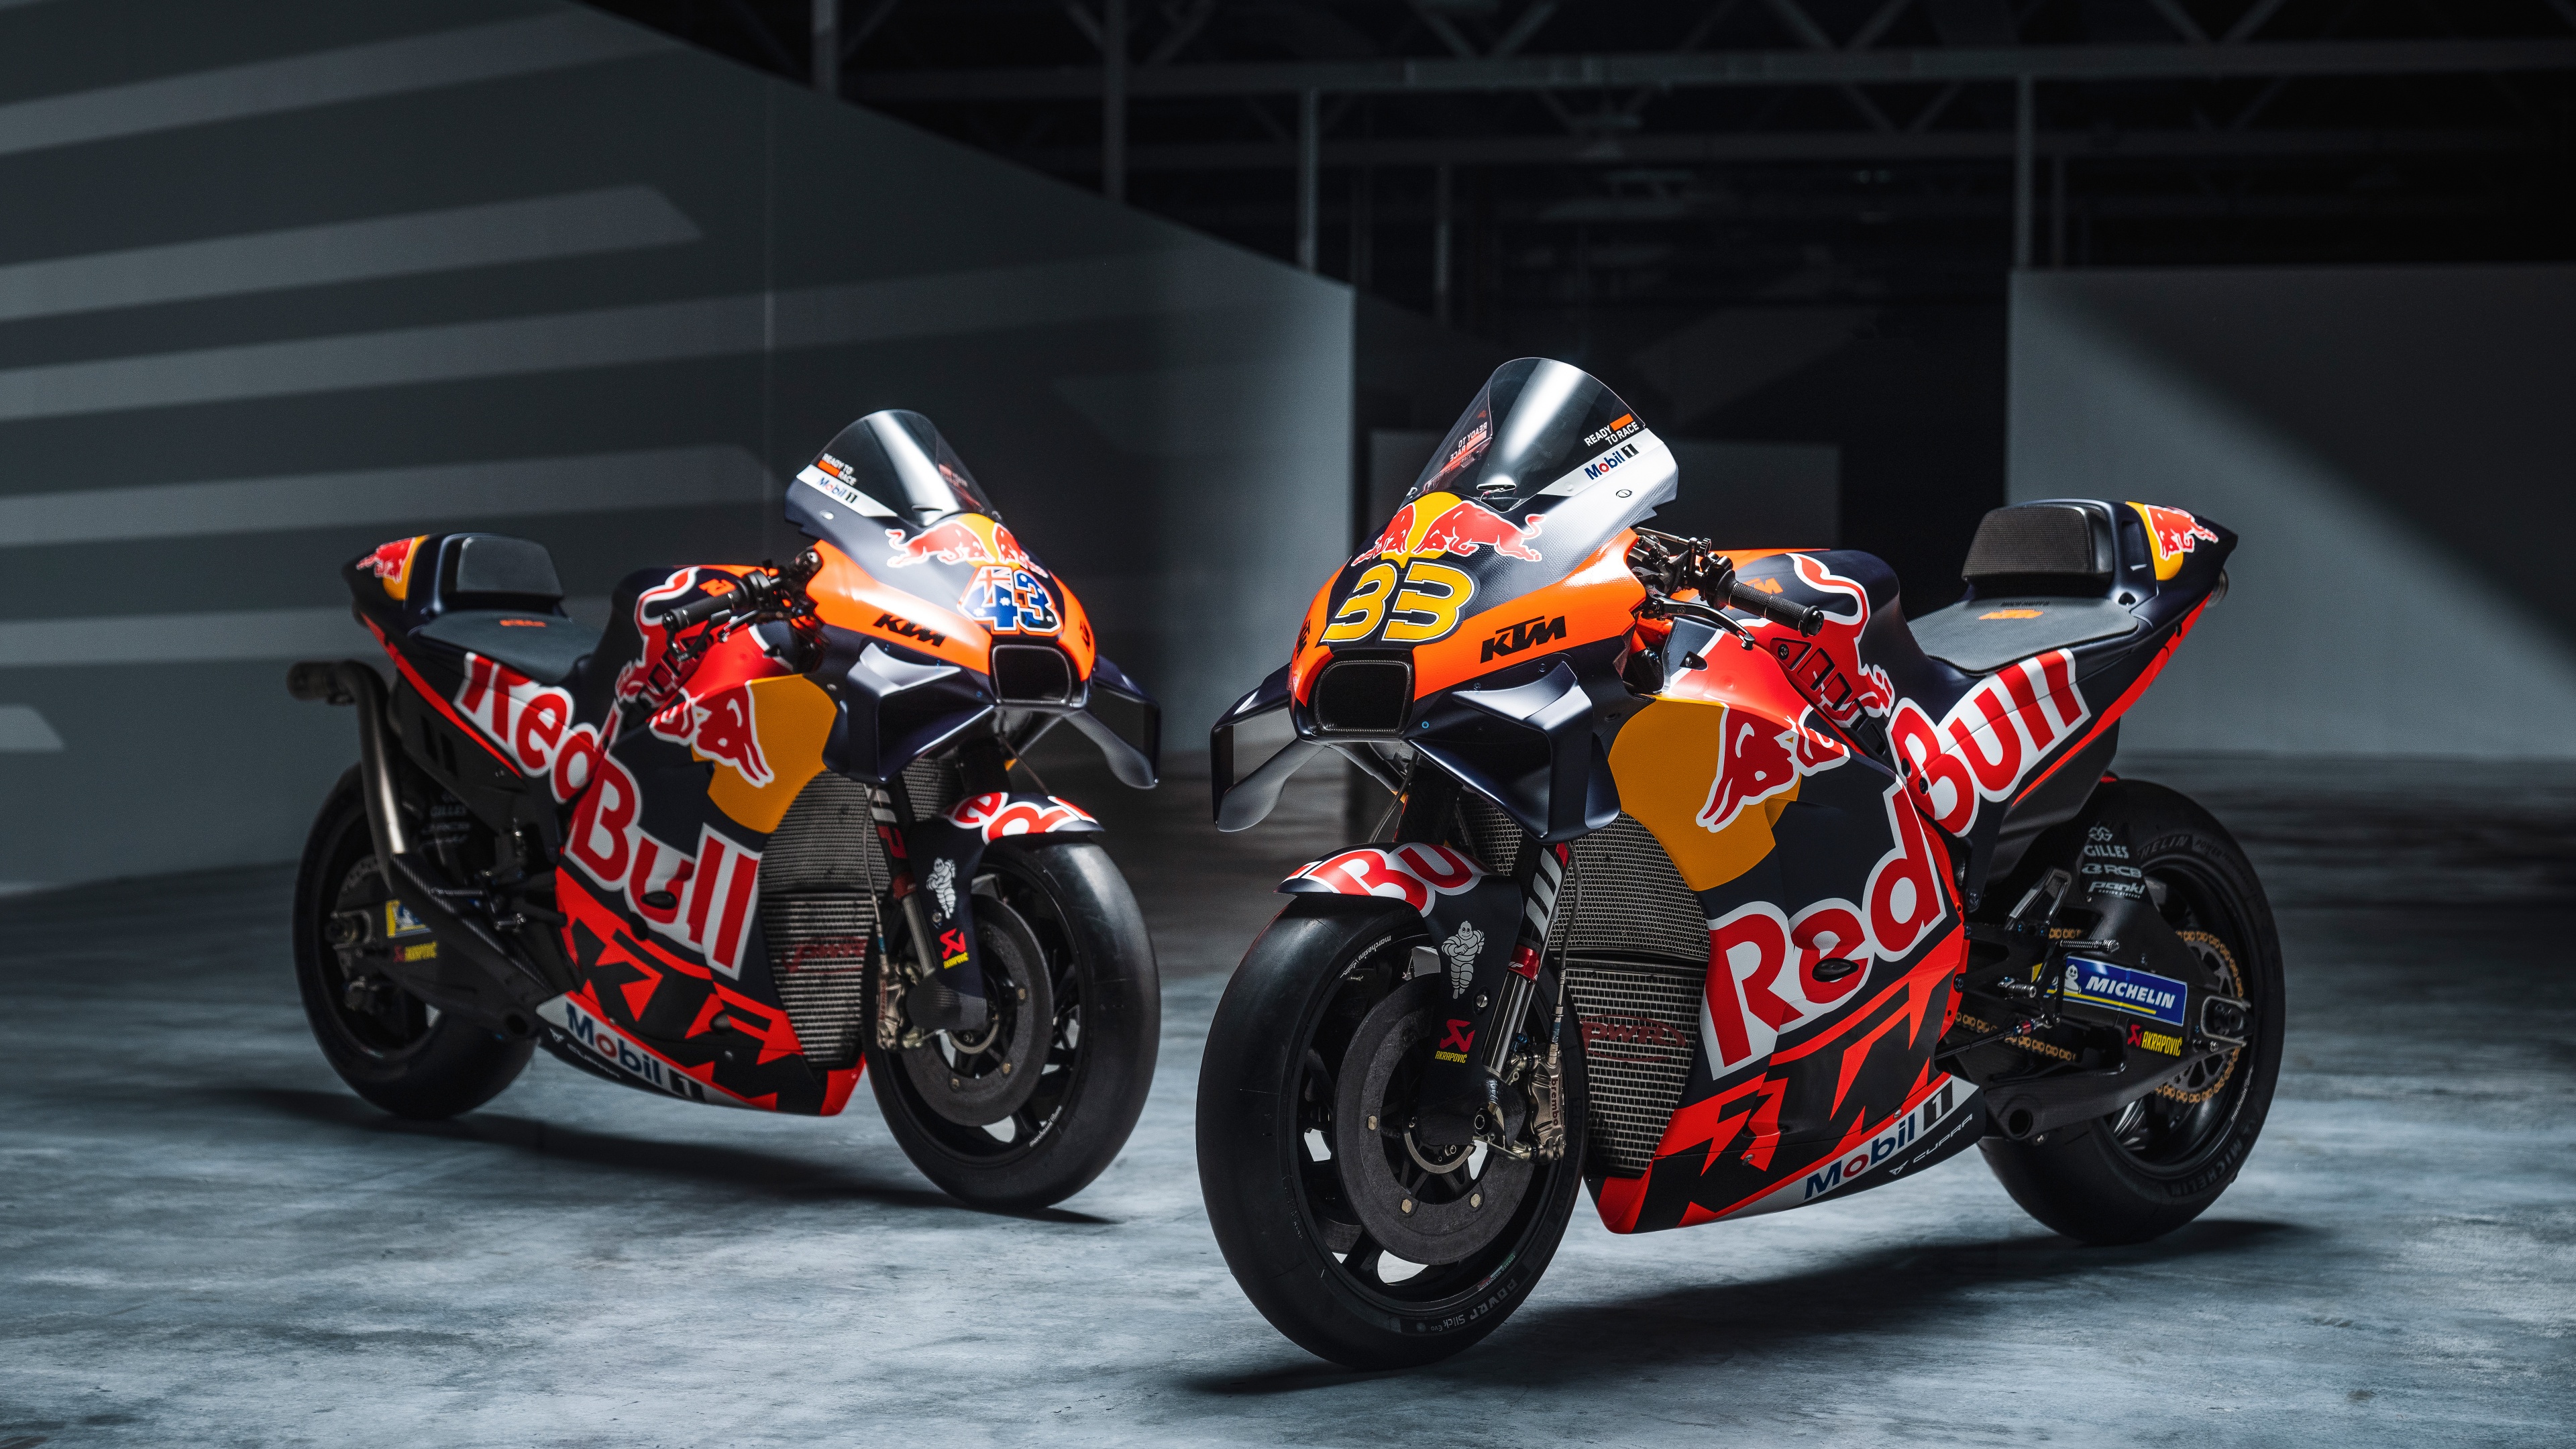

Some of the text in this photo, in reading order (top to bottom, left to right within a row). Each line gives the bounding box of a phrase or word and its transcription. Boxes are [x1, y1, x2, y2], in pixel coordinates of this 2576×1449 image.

[1584, 425, 1612, 447] READY
[1605, 421, 1640, 445] TO RACE
[822, 453, 855, 475] READY TO
[837, 471, 857, 486] RACE
[1584, 450, 1626, 480] Mobil
[818, 477, 847, 497] Mobil
[960, 566, 1062, 633] 43
[1320, 561, 1475, 643] 33
[873, 613, 947, 647] KTM
[1480, 615, 1567, 664] KTM
[949, 792, 1073, 843] ed
[568, 753, 761, 973] Bull
[1704, 649, 2085, 1069] Red Bull
[2083, 845, 2129, 859] GILLES
[2104, 863, 2143, 879] RCB
[1305, 843, 1480, 914] Bu
[1358, 935, 1391, 961] marchesini
[2085, 975, 2176, 1009] MICHELIN
[570, 916, 829, 1113] KTM
[566, 1002, 662, 1086] Mobil
[1581, 1022, 1678, 1055] PWR
[1551, 1078, 1560, 1126] brembo
[1633, 969, 1956, 1232] KTM
[1804, 1112, 1915, 1201] Mobil
[1913, 1114, 1973, 1164] CUPRA
[1442, 1314, 1466, 1329] Slick
